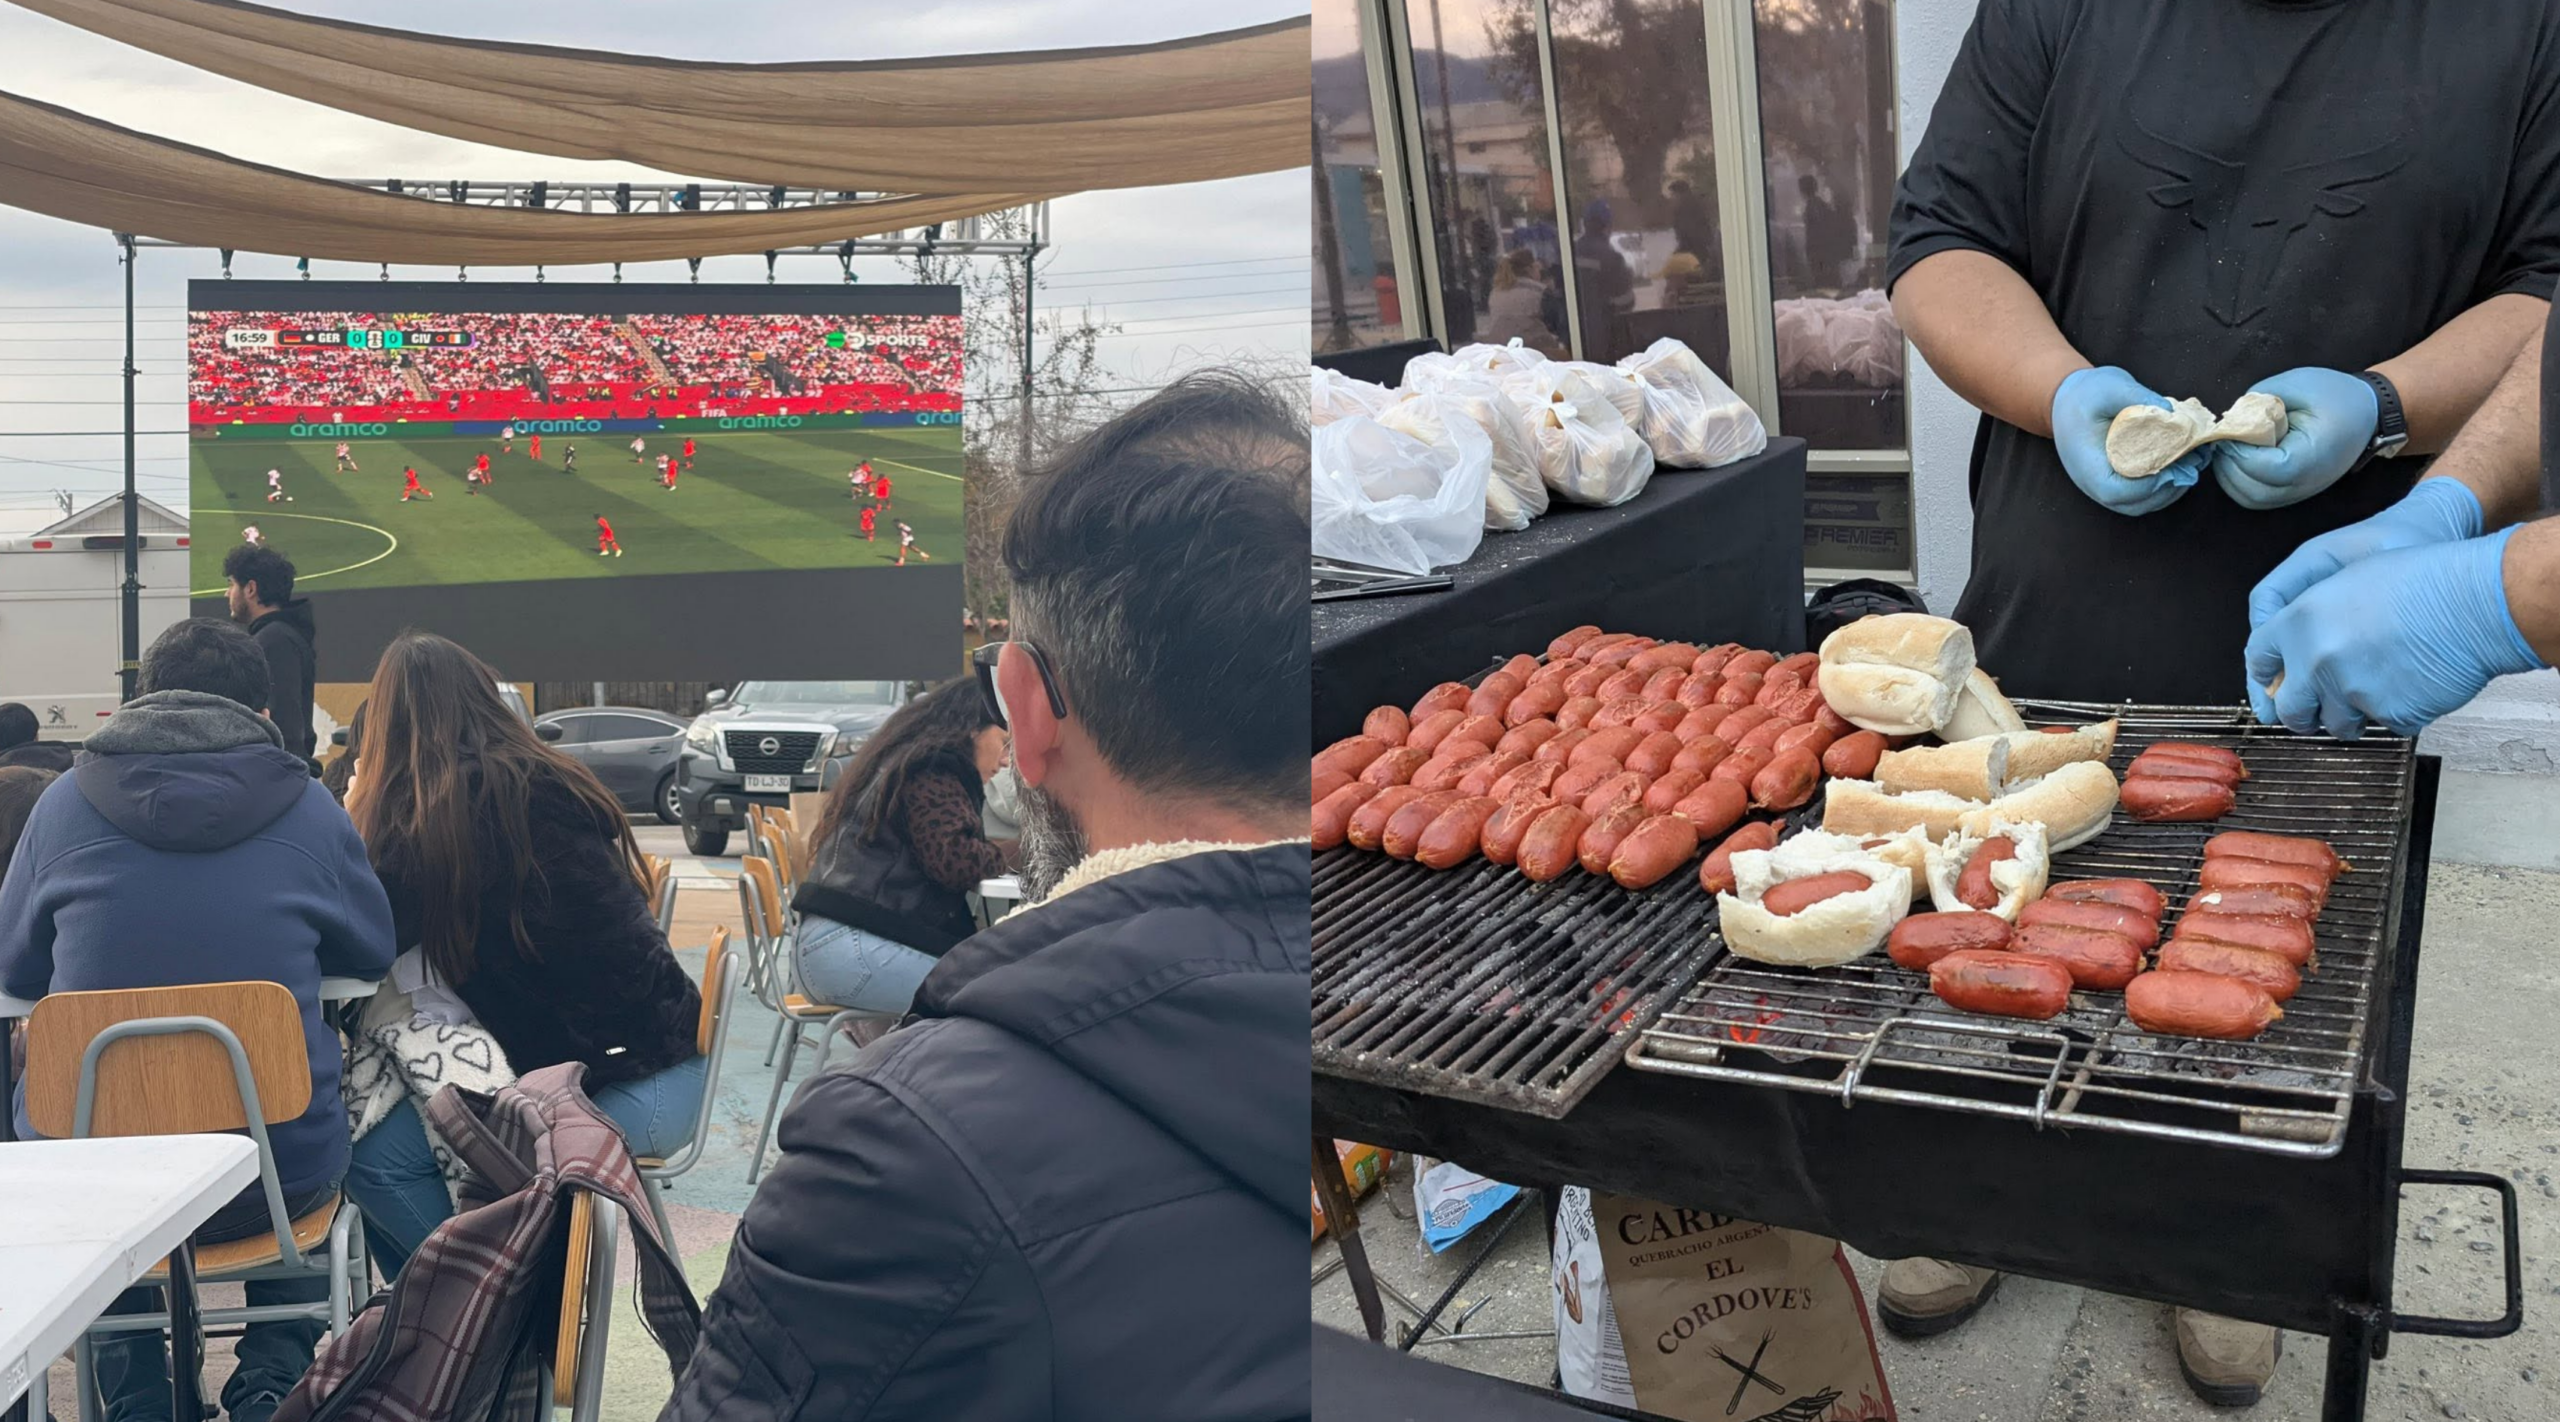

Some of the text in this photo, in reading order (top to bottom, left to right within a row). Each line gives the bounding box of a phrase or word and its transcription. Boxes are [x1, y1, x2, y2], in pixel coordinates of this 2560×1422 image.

[232, 333, 268, 343] 16:59
[318, 333, 341, 343] GER
[353, 333, 362, 344] 0
[389, 333, 398, 344] 0
[411, 333, 432, 344] CIV
[701, 408, 728, 418] FIFA
[514, 418, 602, 434] aramco
[719, 415, 803, 429] aramco
[290, 422, 388, 437] aramco
[1629, 1240, 1713, 1267] QUEBRACHO
[1704, 1257, 1744, 1281] EL
[1657, 1286, 1812, 1355] CORDOVE'S
